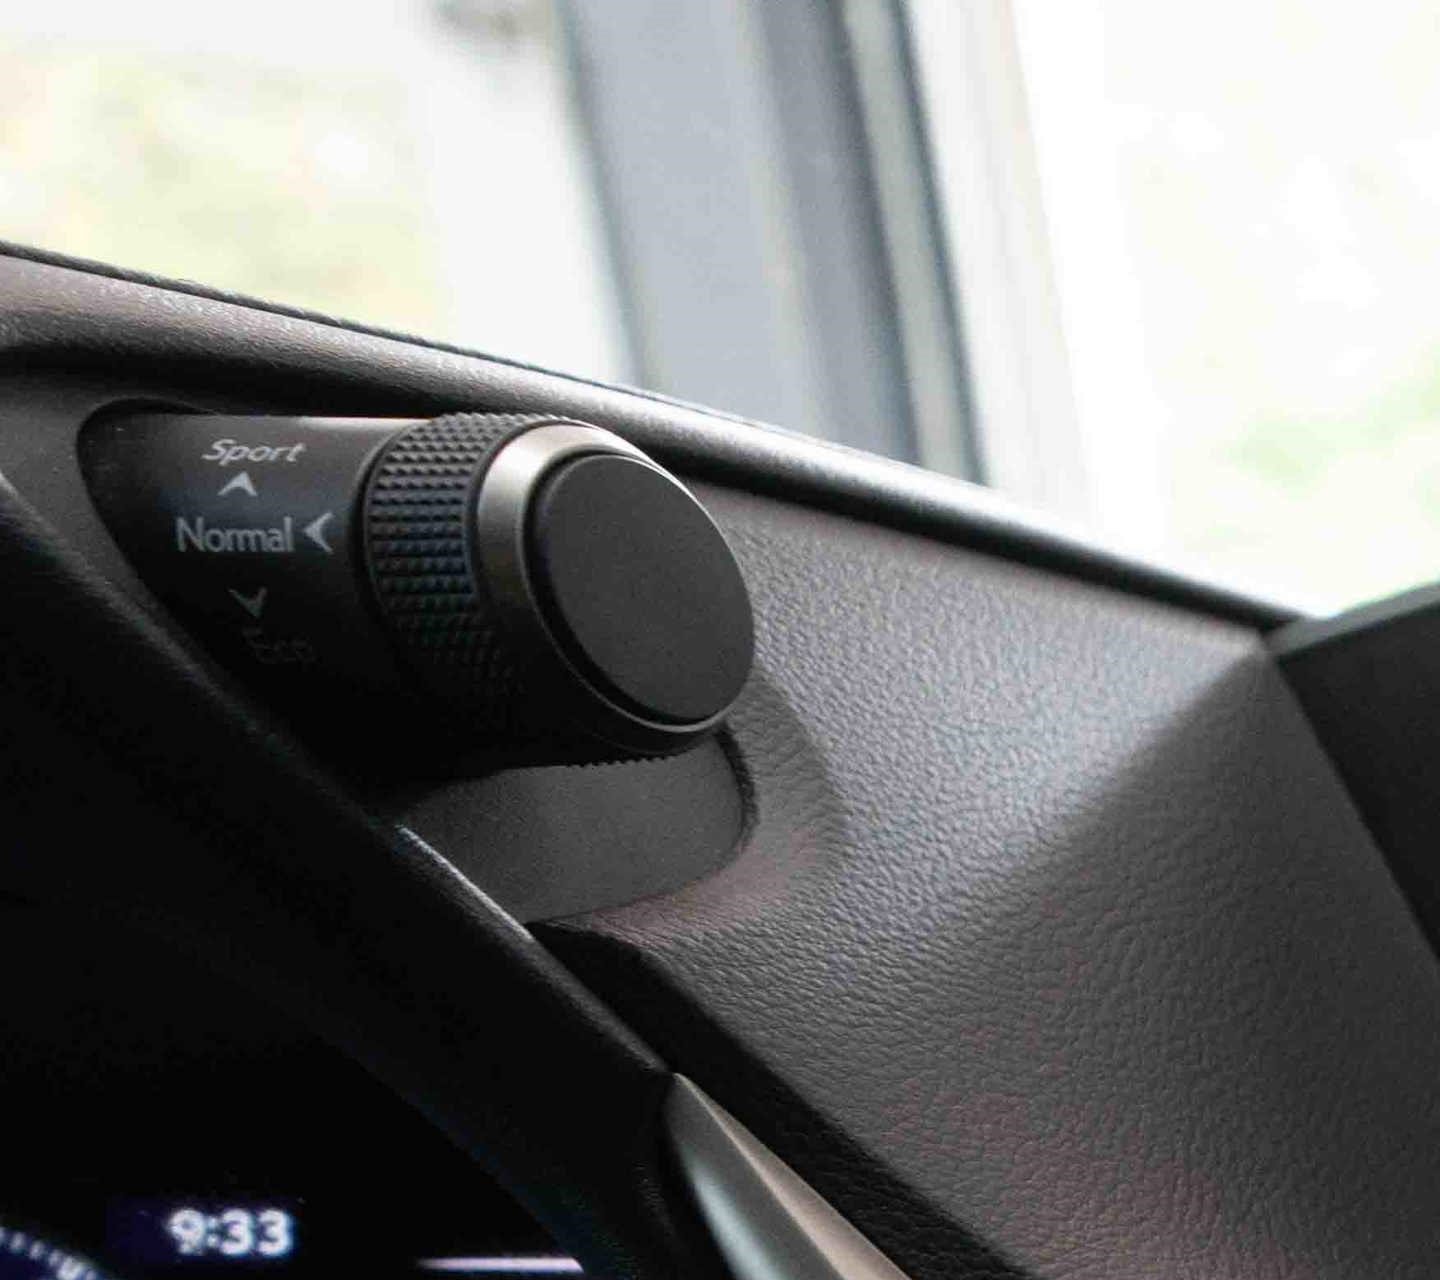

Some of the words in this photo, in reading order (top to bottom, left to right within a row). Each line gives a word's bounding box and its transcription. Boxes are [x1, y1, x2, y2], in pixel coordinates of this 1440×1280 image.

[202, 438, 306, 466] Sport
[176, 516, 294, 554] Normal
[167, 1208, 293, 1257] 9:33
